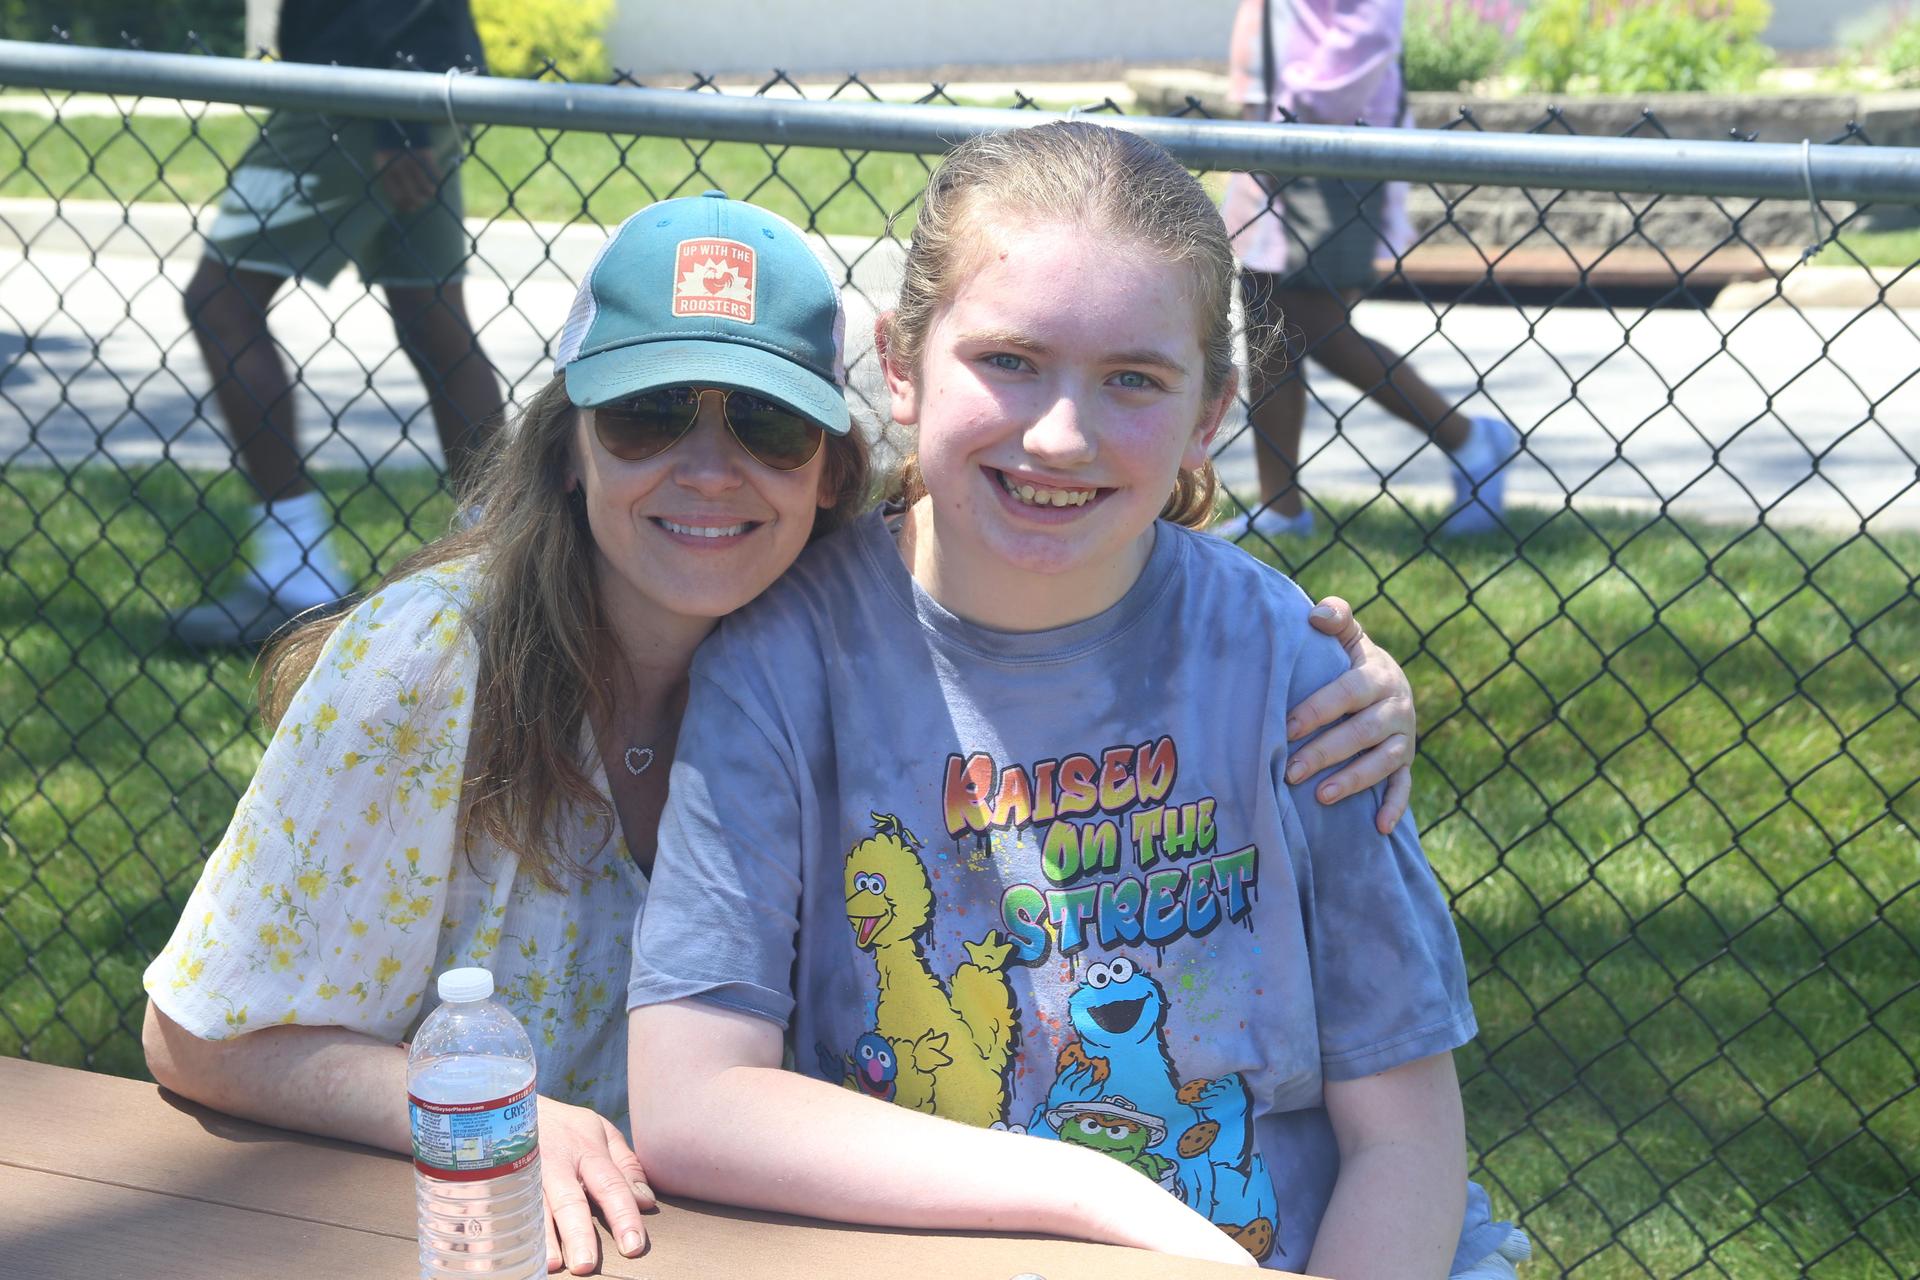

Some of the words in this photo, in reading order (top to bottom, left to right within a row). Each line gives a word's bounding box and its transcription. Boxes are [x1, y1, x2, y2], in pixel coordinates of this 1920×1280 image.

[683, 245, 697, 257] UP
[700, 245, 728, 257] WITH
[732, 247, 750, 262] THE
[680, 299, 747, 316] ROOSTERS
[944, 735, 1177, 842] RAISED
[1131, 796, 1218, 870] THE
[1001, 844, 1258, 962] STREET
